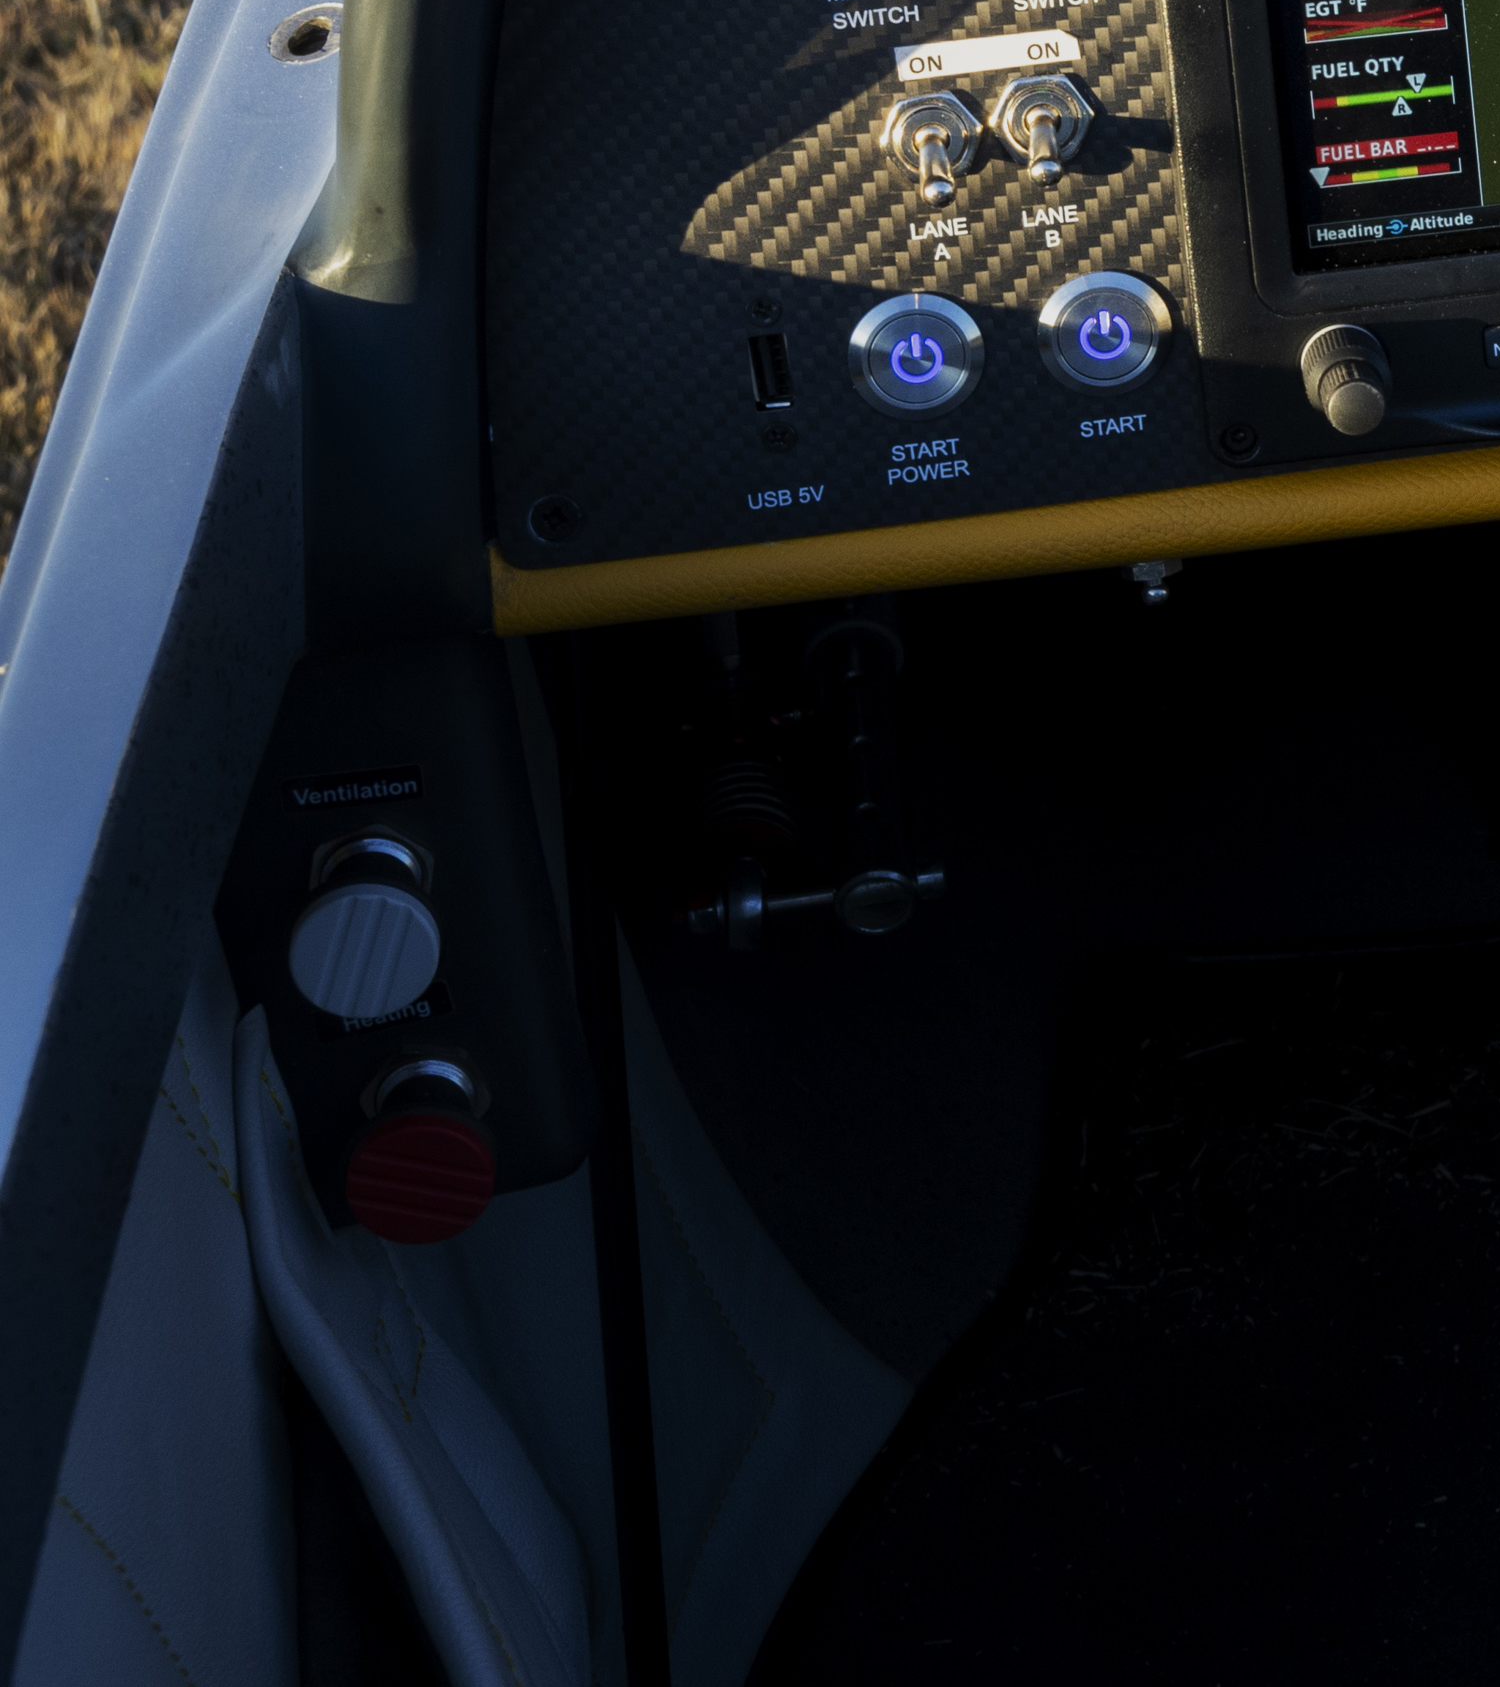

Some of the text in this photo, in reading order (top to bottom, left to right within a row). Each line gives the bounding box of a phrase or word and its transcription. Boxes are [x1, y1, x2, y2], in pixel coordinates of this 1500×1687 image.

[832, 4, 921, 31] SWITCH
[1310, 55, 1405, 81] FUEL QTY
[1316, 210, 1474, 245] Heading Altitude
[1079, 414, 1148, 440] START
[890, 438, 960, 463] START
[887, 458, 971, 485] POWER
[747, 484, 825, 511] USB 5V
[292, 778, 418, 806] Ventilation
